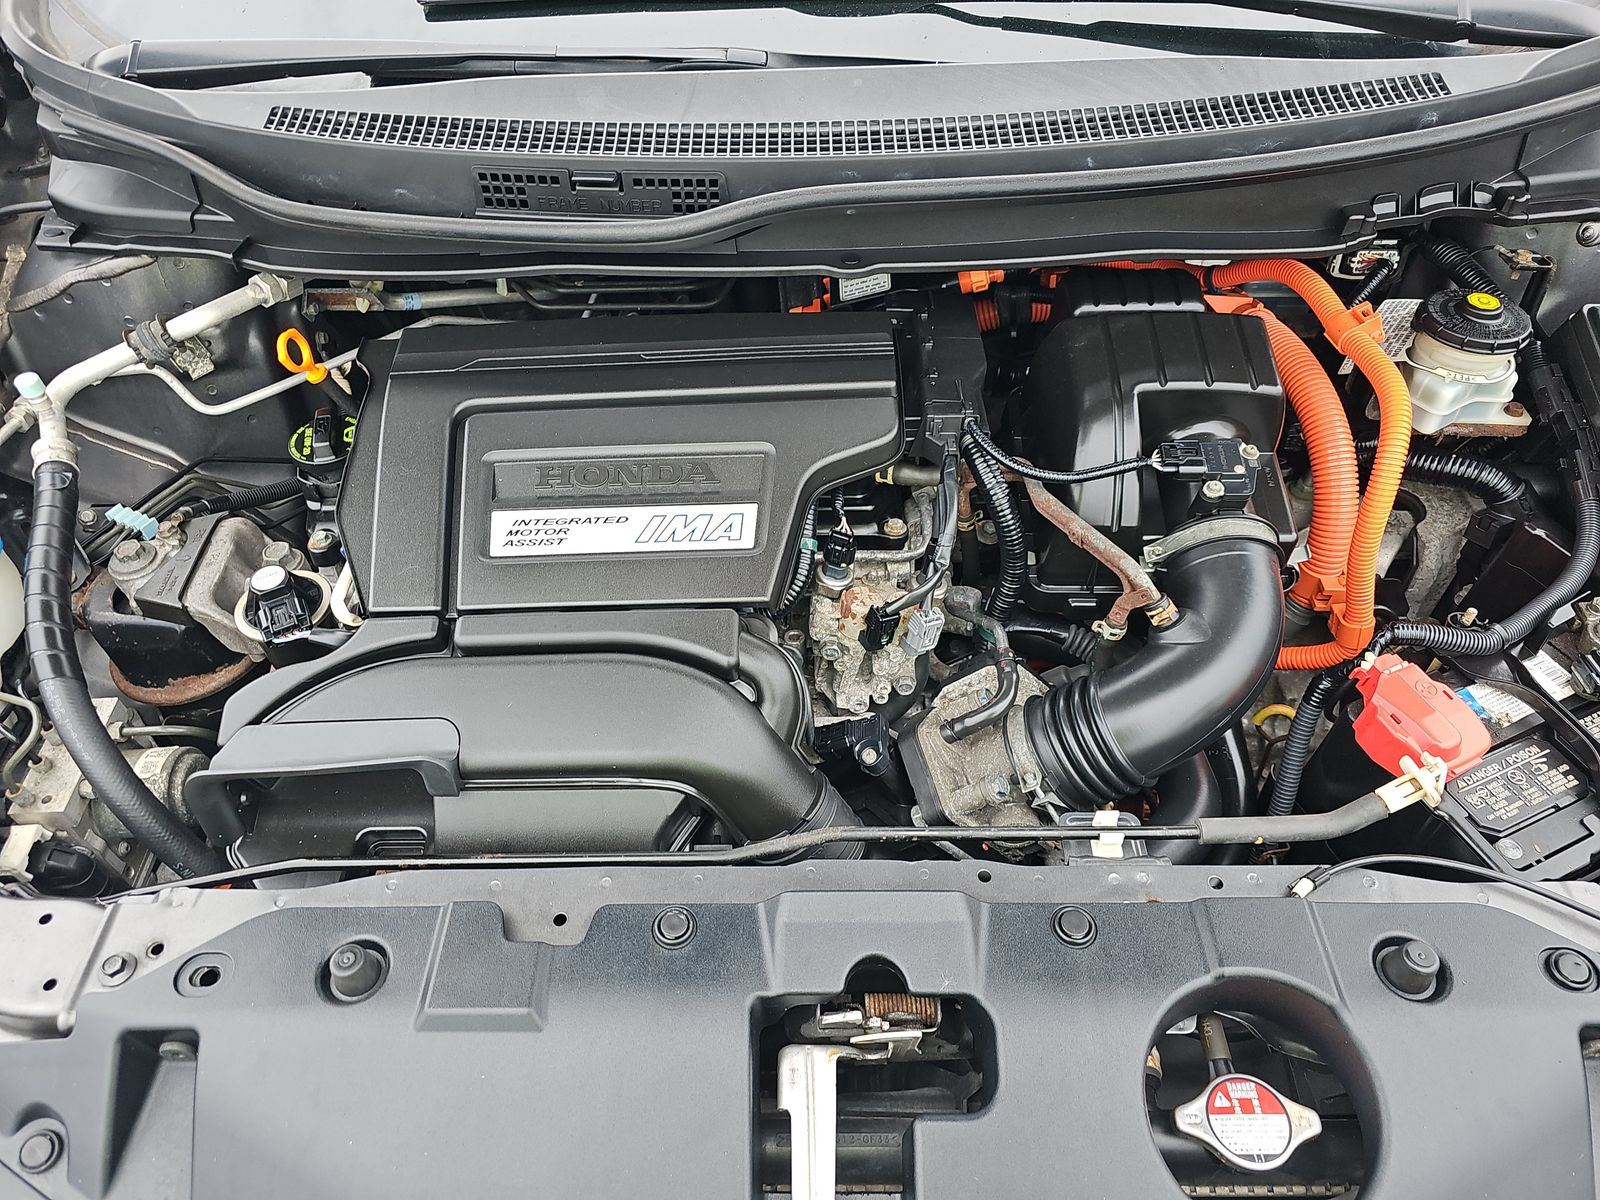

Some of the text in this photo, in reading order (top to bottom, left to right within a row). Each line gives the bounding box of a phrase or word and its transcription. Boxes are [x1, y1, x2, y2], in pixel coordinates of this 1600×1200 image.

[534, 462, 721, 489] HONDA
[511, 516, 629, 527] INTEGRATED
[635, 513, 744, 543] IMA
[506, 528, 570, 537] MOTOR
[503, 538, 568, 547] ASSIST
[1463, 762, 1502, 785] DANGER
[1506, 745, 1541, 765] POISON
